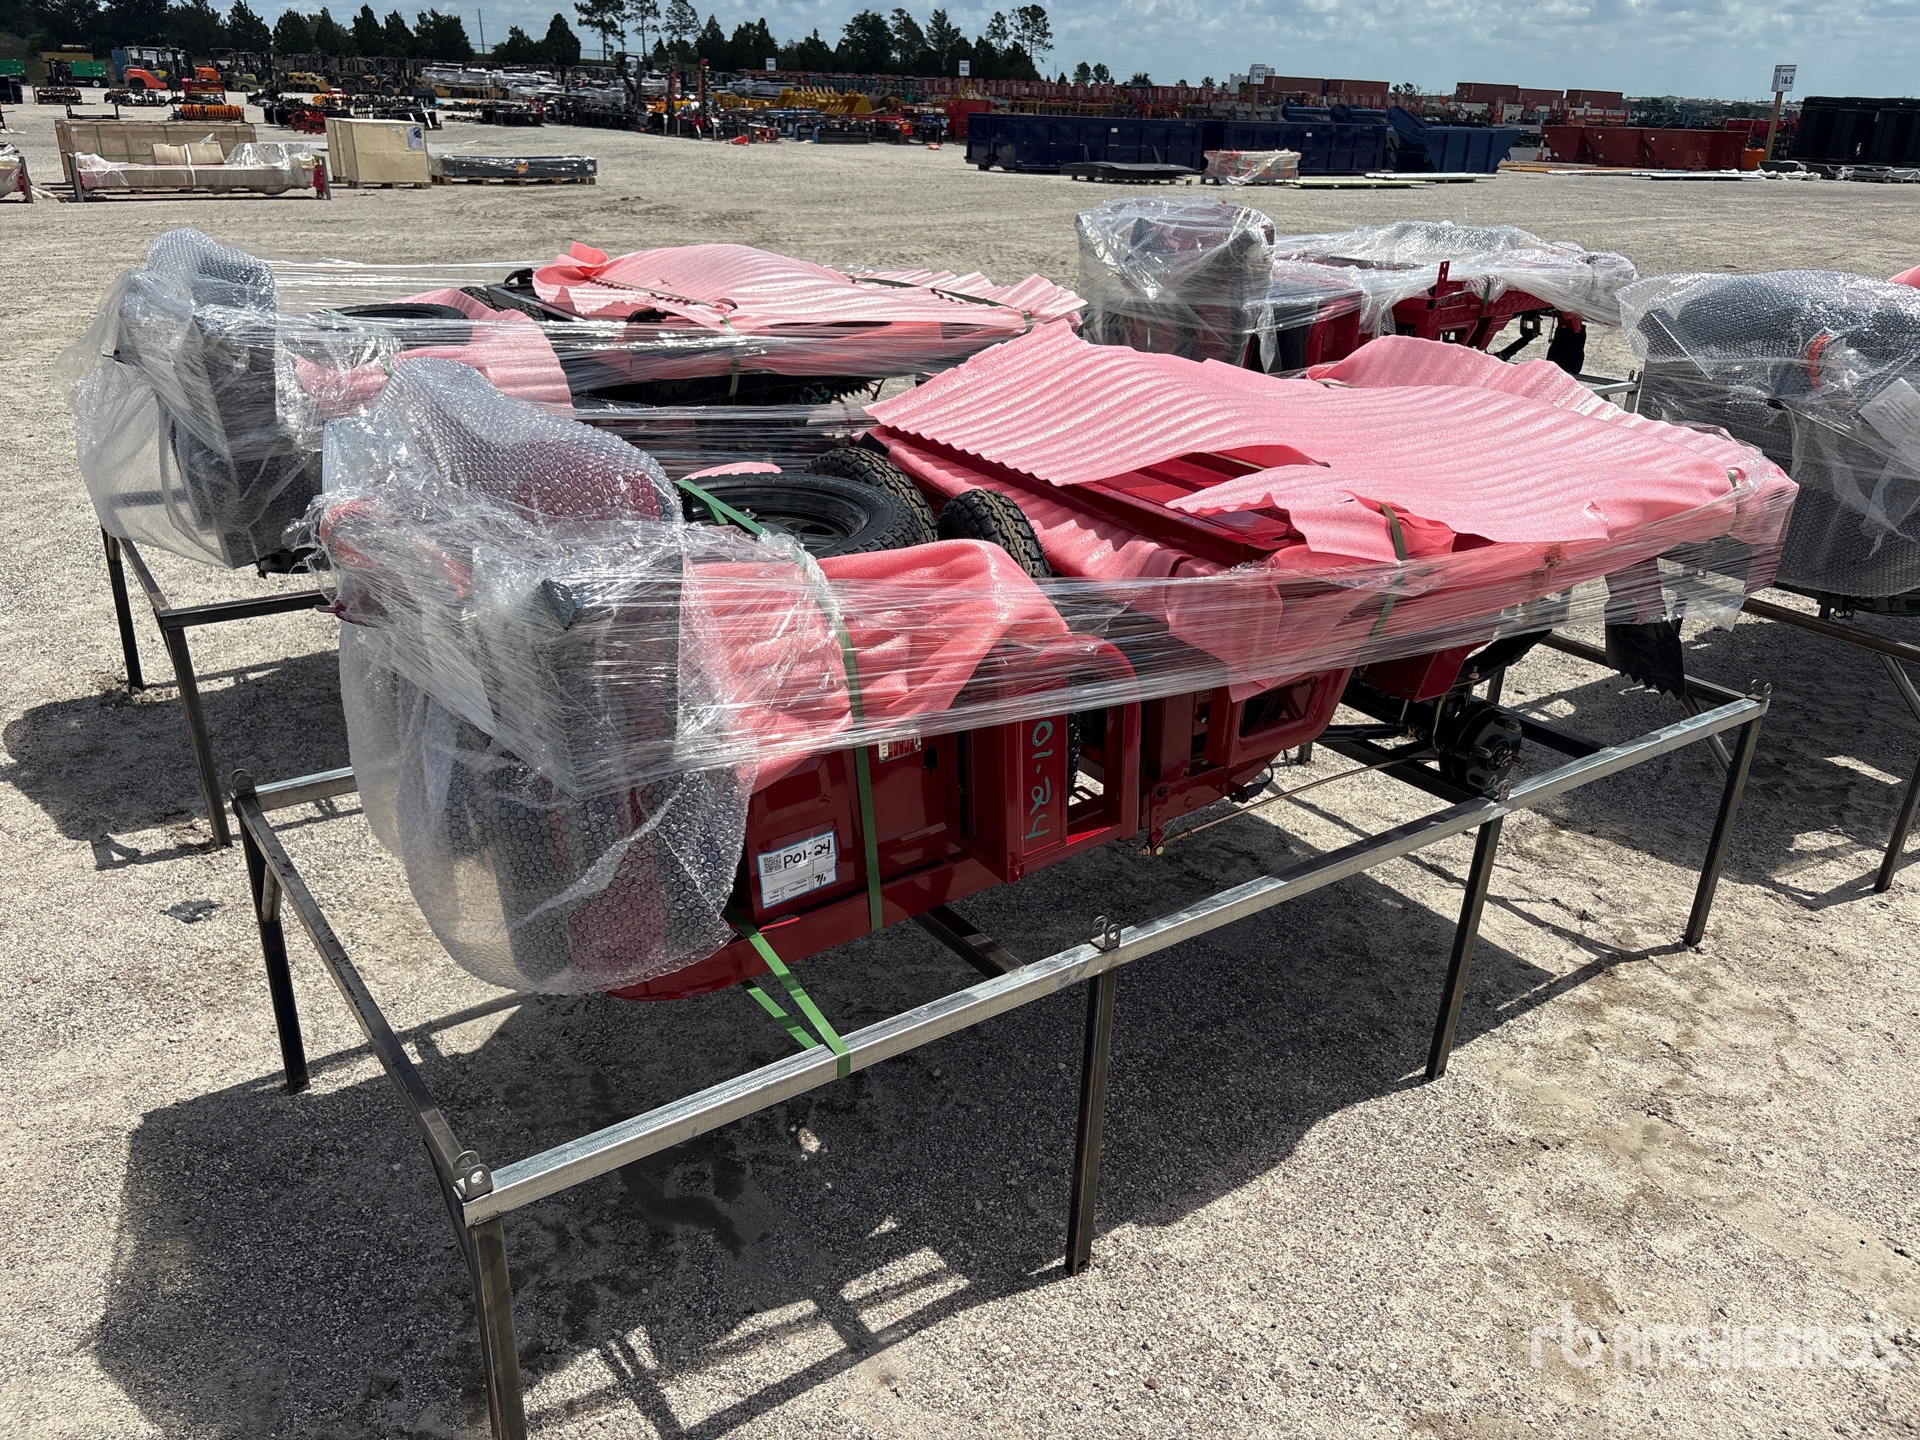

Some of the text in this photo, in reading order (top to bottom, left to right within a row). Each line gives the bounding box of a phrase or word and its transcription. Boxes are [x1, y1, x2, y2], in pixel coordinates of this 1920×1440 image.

[1780, 76, 1794, 84] 1&2
[1025, 703, 1054, 840] 01-24
[784, 839, 831, 868] P01-24
